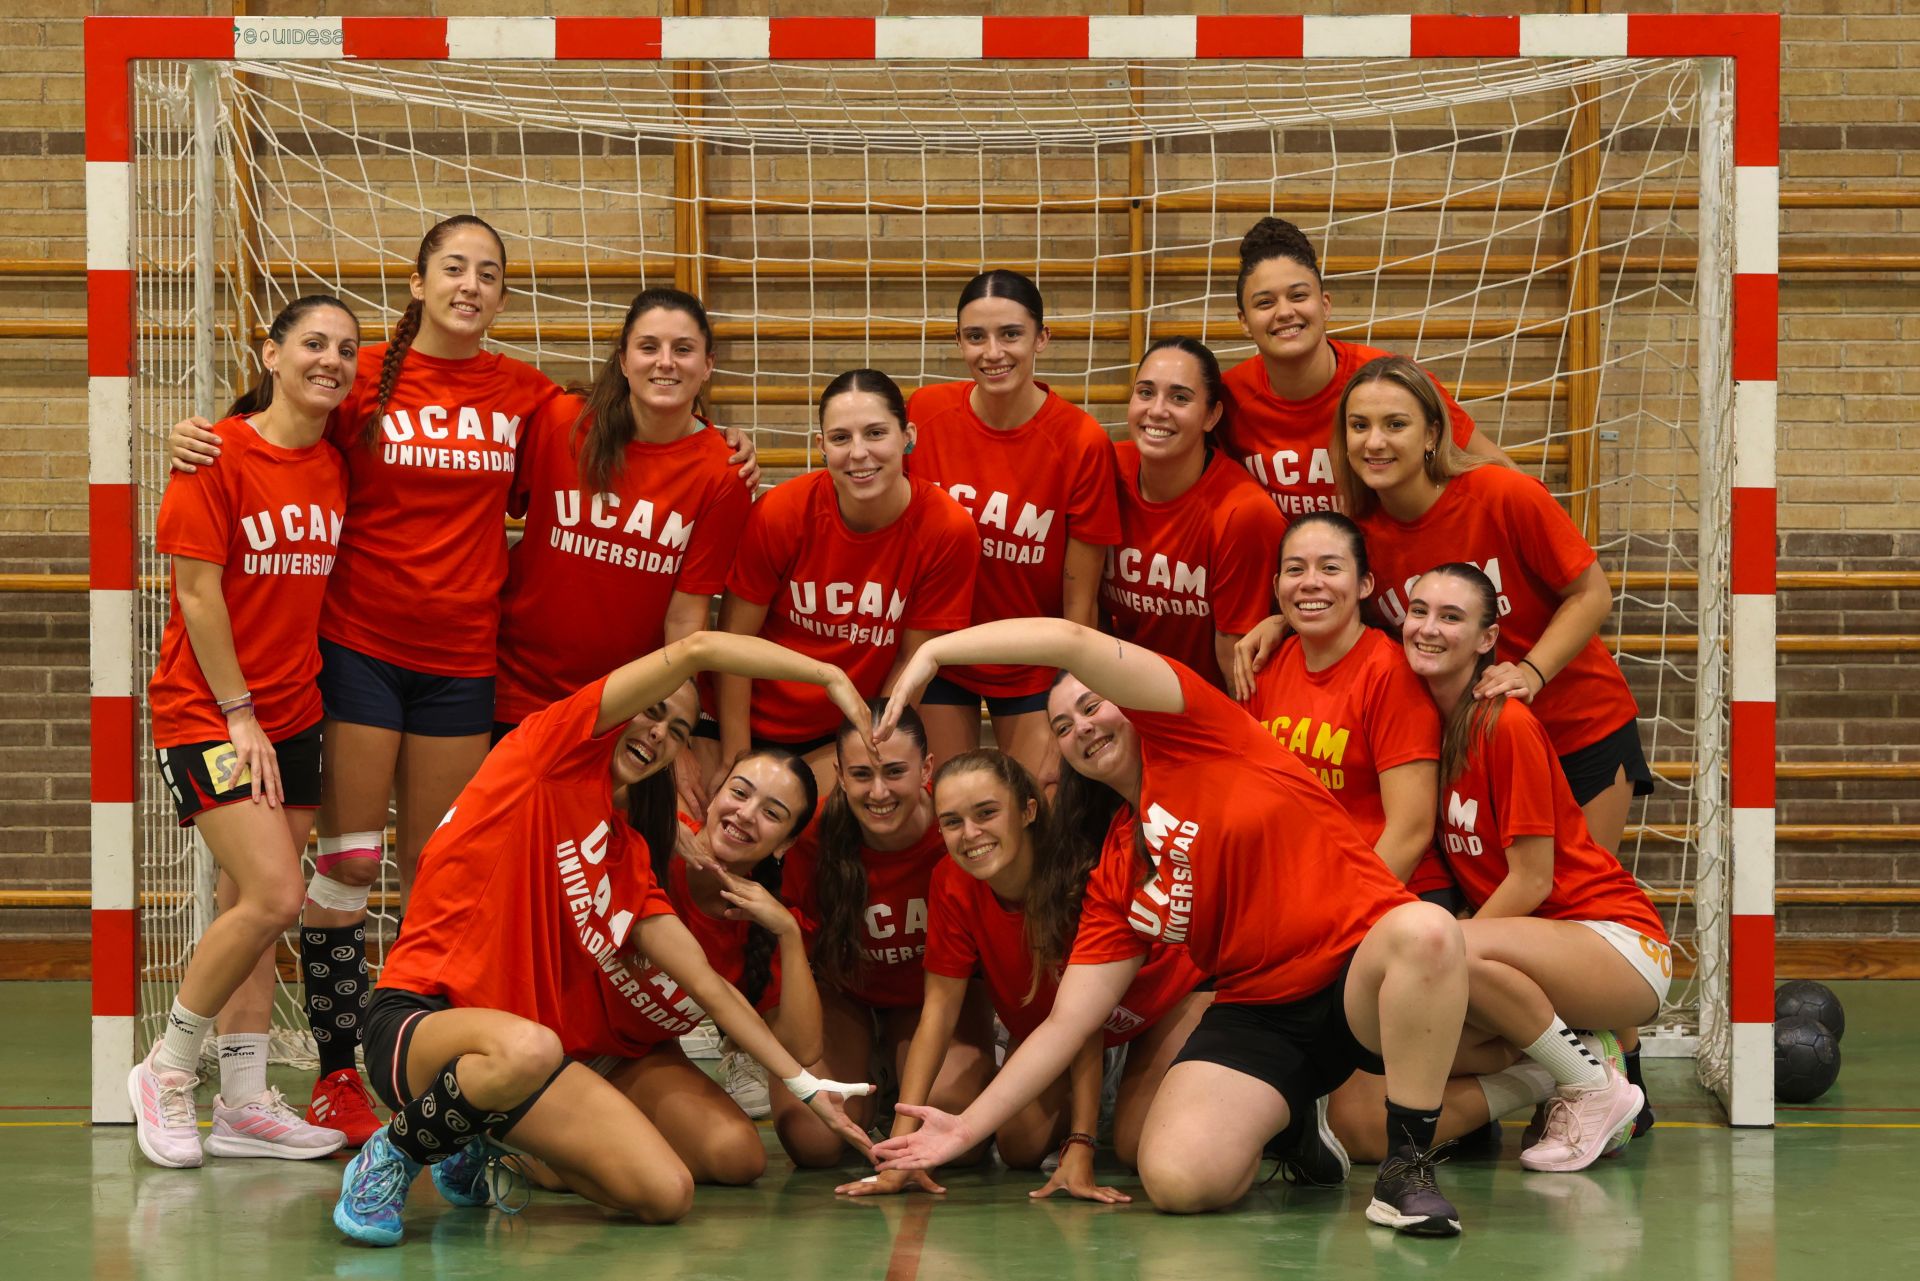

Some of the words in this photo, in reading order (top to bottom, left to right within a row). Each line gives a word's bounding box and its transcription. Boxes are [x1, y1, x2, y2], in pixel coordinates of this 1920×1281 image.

[382, 405, 521, 449] UCAM
[1245, 448, 1335, 486] UCA
[554, 489, 695, 552] UCAM
[933, 481, 1055, 543] CAM
[1260, 716, 1350, 766] CAM
[864, 898, 928, 940] CA
